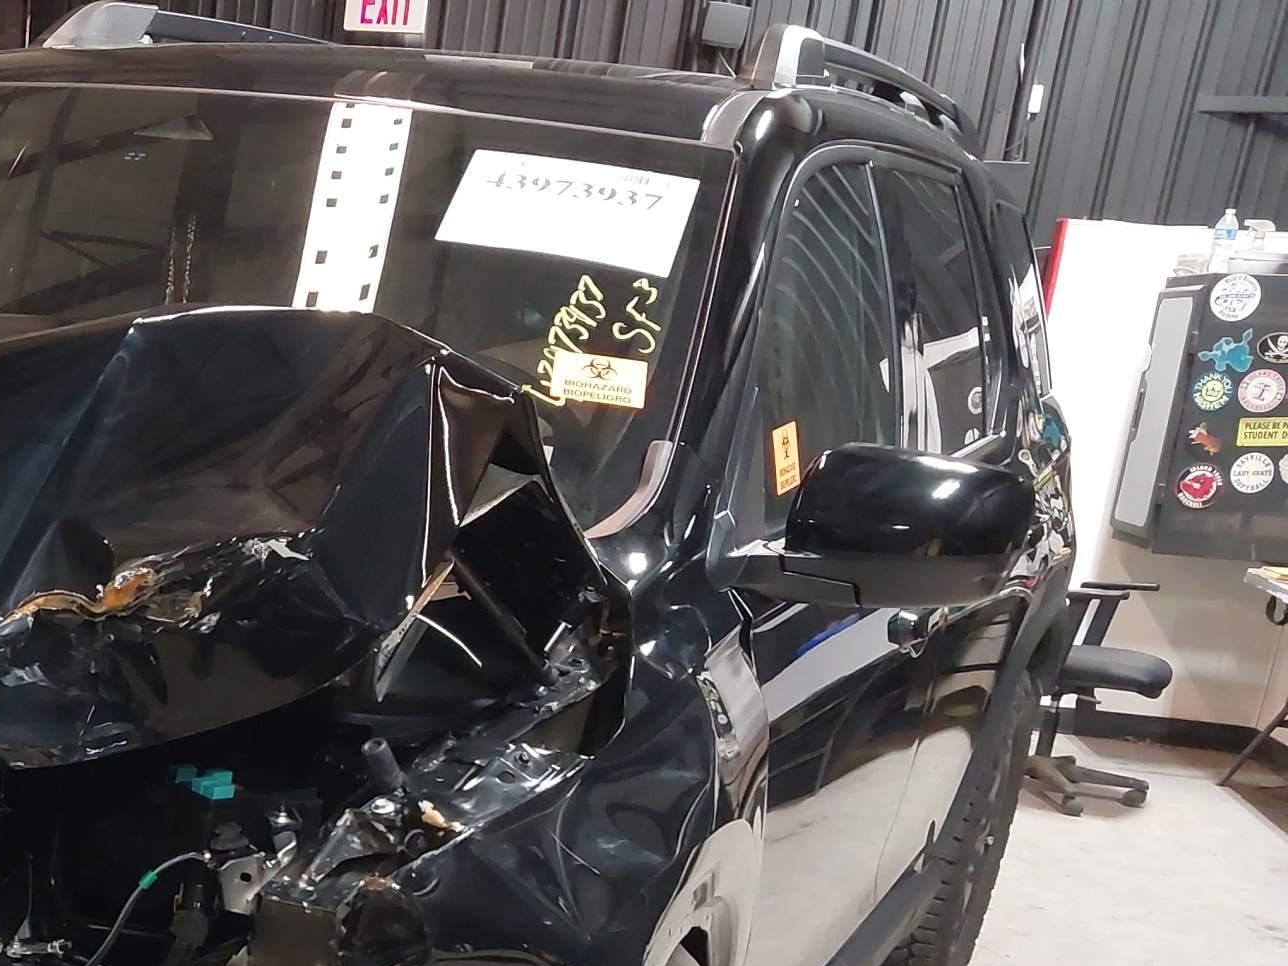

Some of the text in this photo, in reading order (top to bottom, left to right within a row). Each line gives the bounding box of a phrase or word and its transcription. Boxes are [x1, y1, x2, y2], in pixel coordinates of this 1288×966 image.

[564, 379, 632, 394] BIOHAZARD
[563, 389, 632, 404] BIOPELIGRO
[1245, 422, 1271, 430] PLEASE
[1243, 431, 1278, 440] STUDENT
